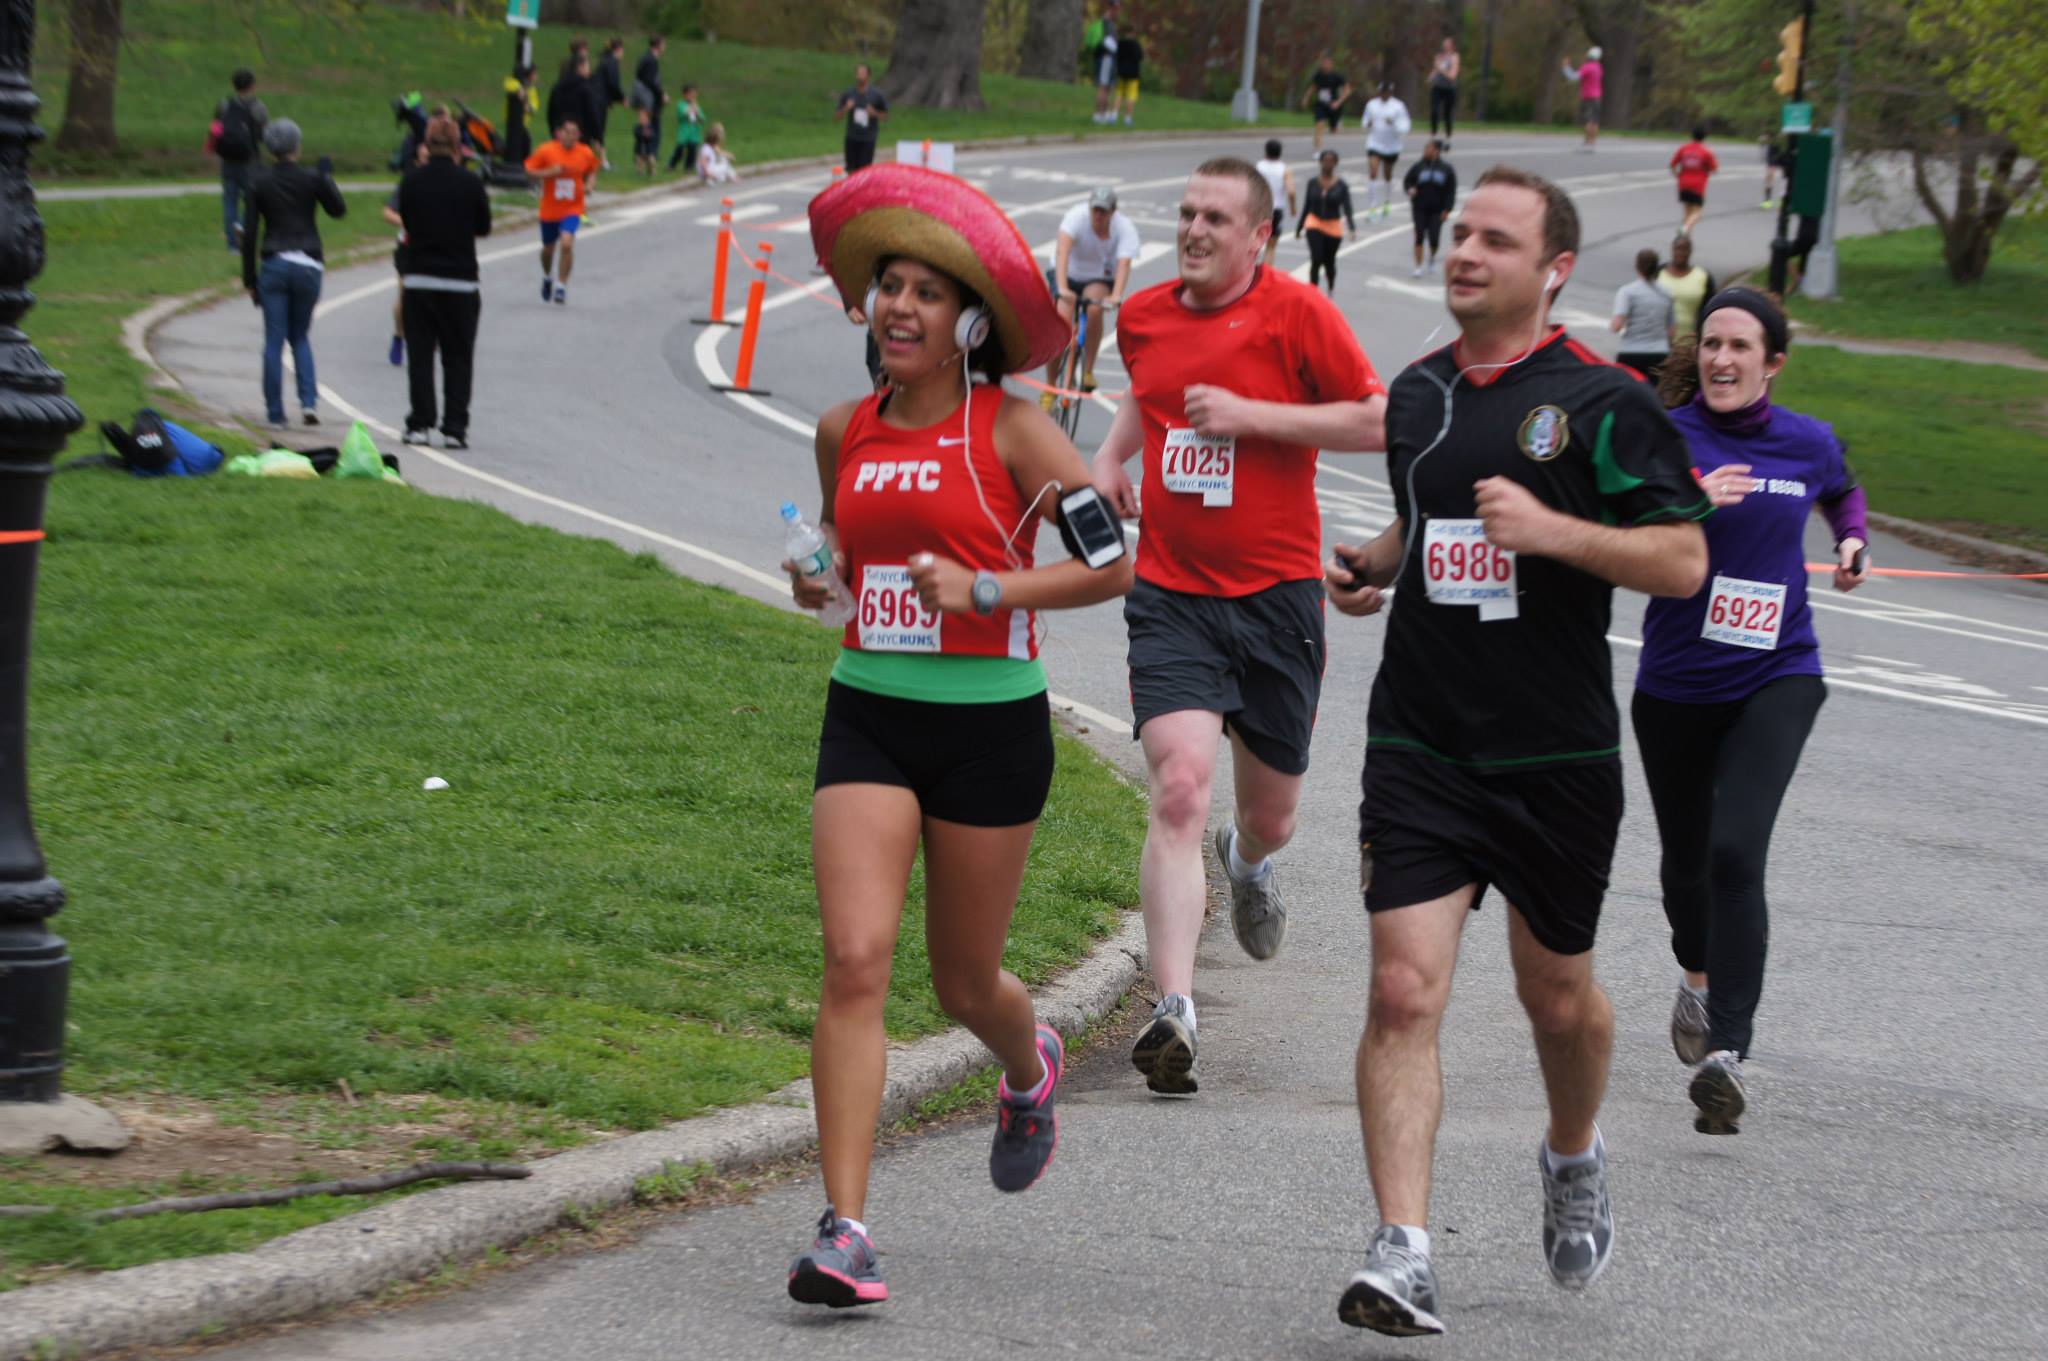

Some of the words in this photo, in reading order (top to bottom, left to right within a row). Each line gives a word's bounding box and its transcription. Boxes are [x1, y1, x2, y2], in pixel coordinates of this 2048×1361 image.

[853, 459, 942, 492] PPTC
[1166, 444, 1231, 477] 7025
[1428, 542, 1511, 582] 6986
[1710, 593, 1779, 633] 6922
[875, 632, 934, 647] NYCRUNS
